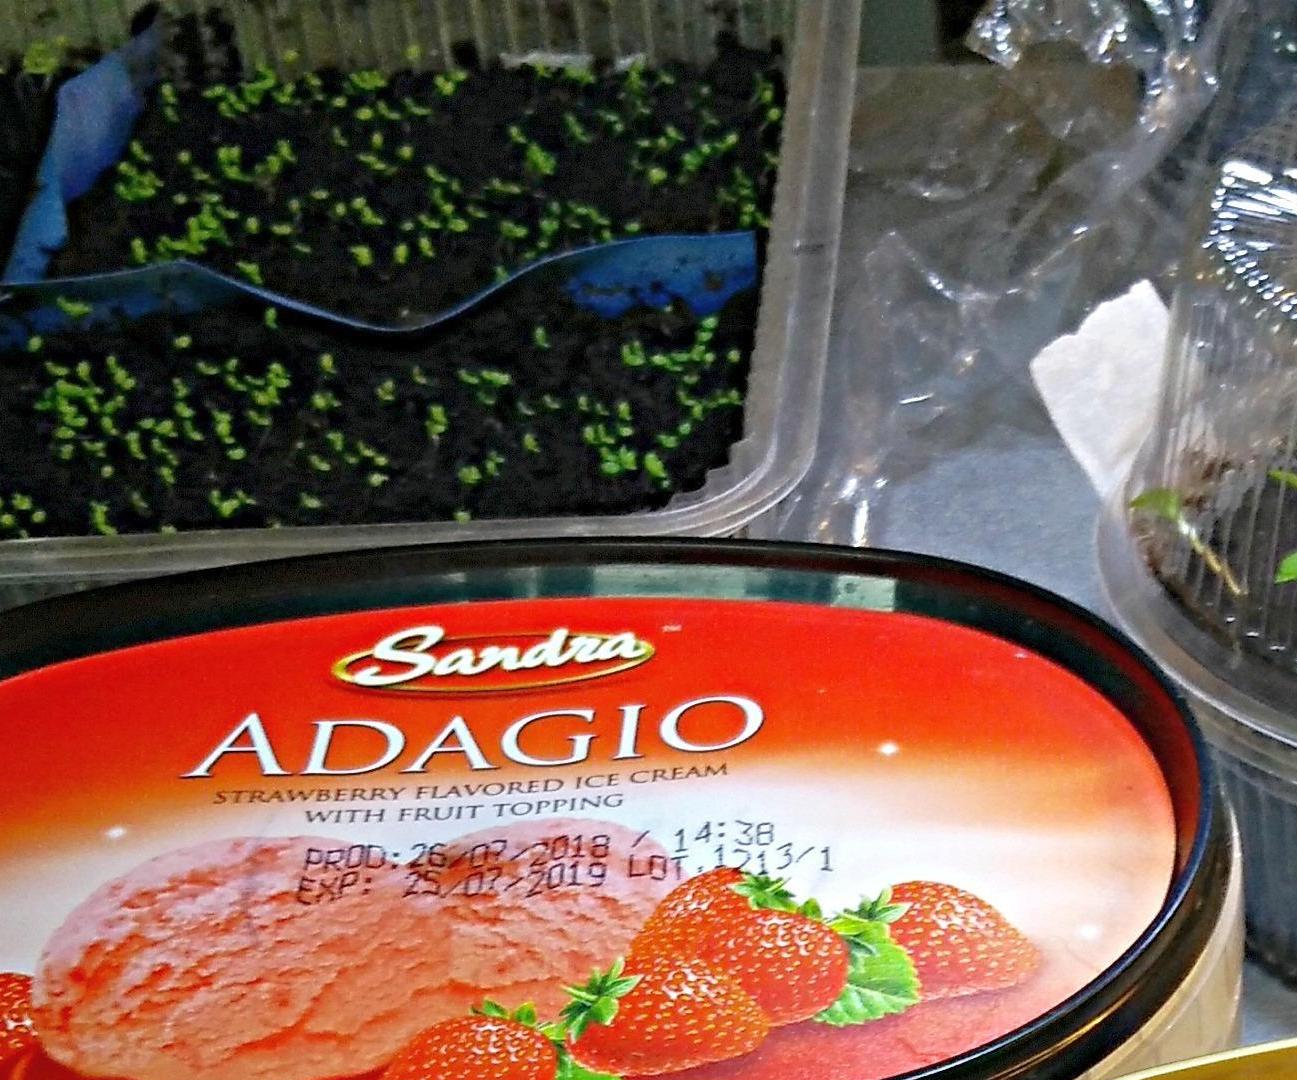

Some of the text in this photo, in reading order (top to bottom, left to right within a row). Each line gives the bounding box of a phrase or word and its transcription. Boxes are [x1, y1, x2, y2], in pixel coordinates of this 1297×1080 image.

[352, 625, 647, 686] Sandra
[179, 695, 765, 778] ADAGIO
[213, 762, 728, 806] STRAWBERRY FLAVORED ICE CREAM
[304, 793, 624, 824] WITH FRUIT TOPPING
[673, 819, 775, 853] 14:38
